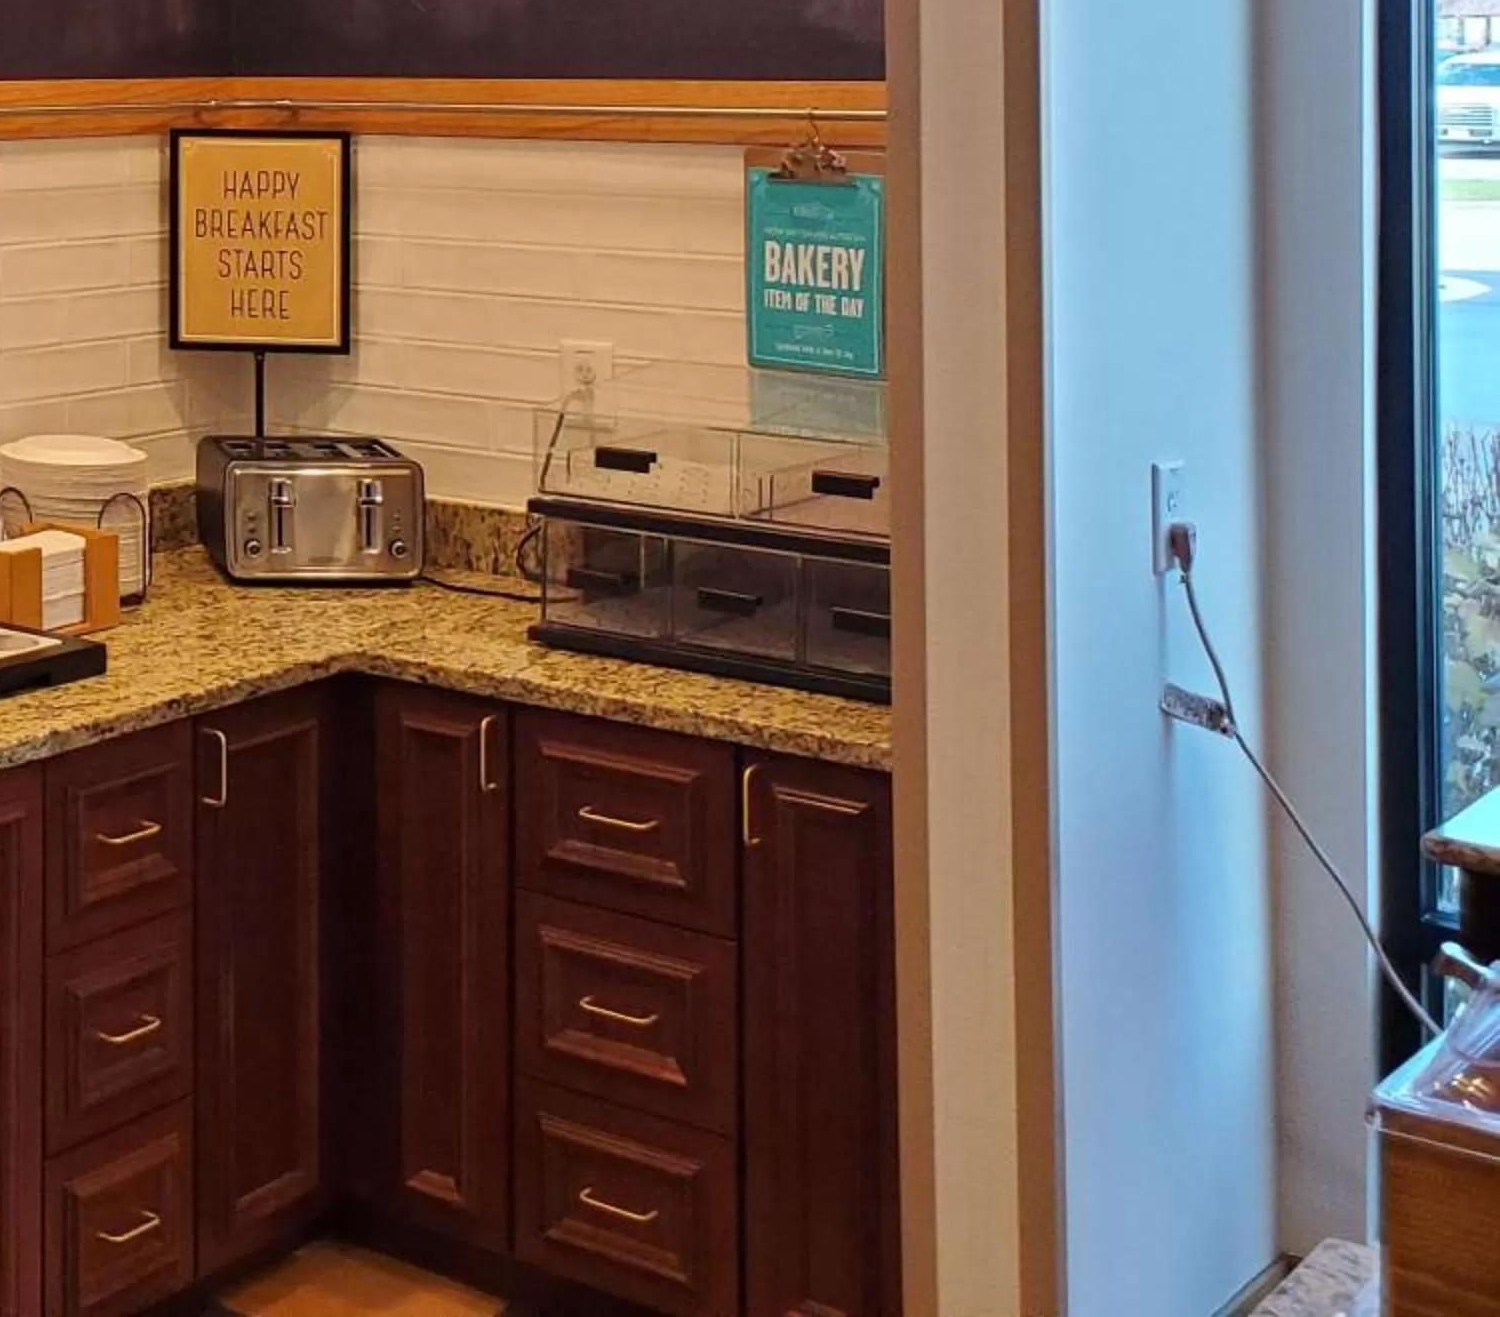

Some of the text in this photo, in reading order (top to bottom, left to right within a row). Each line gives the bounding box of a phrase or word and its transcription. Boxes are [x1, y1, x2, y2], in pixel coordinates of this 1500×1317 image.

[223, 170, 300, 200] HAPPY
[195, 208, 329, 241] BREAKFAST
[218, 248, 303, 280] STARTS
[763, 240, 865, 292] BAKERY
[231, 288, 291, 320] HERE
[763, 288, 864, 319] ITEM OF THE DAY
